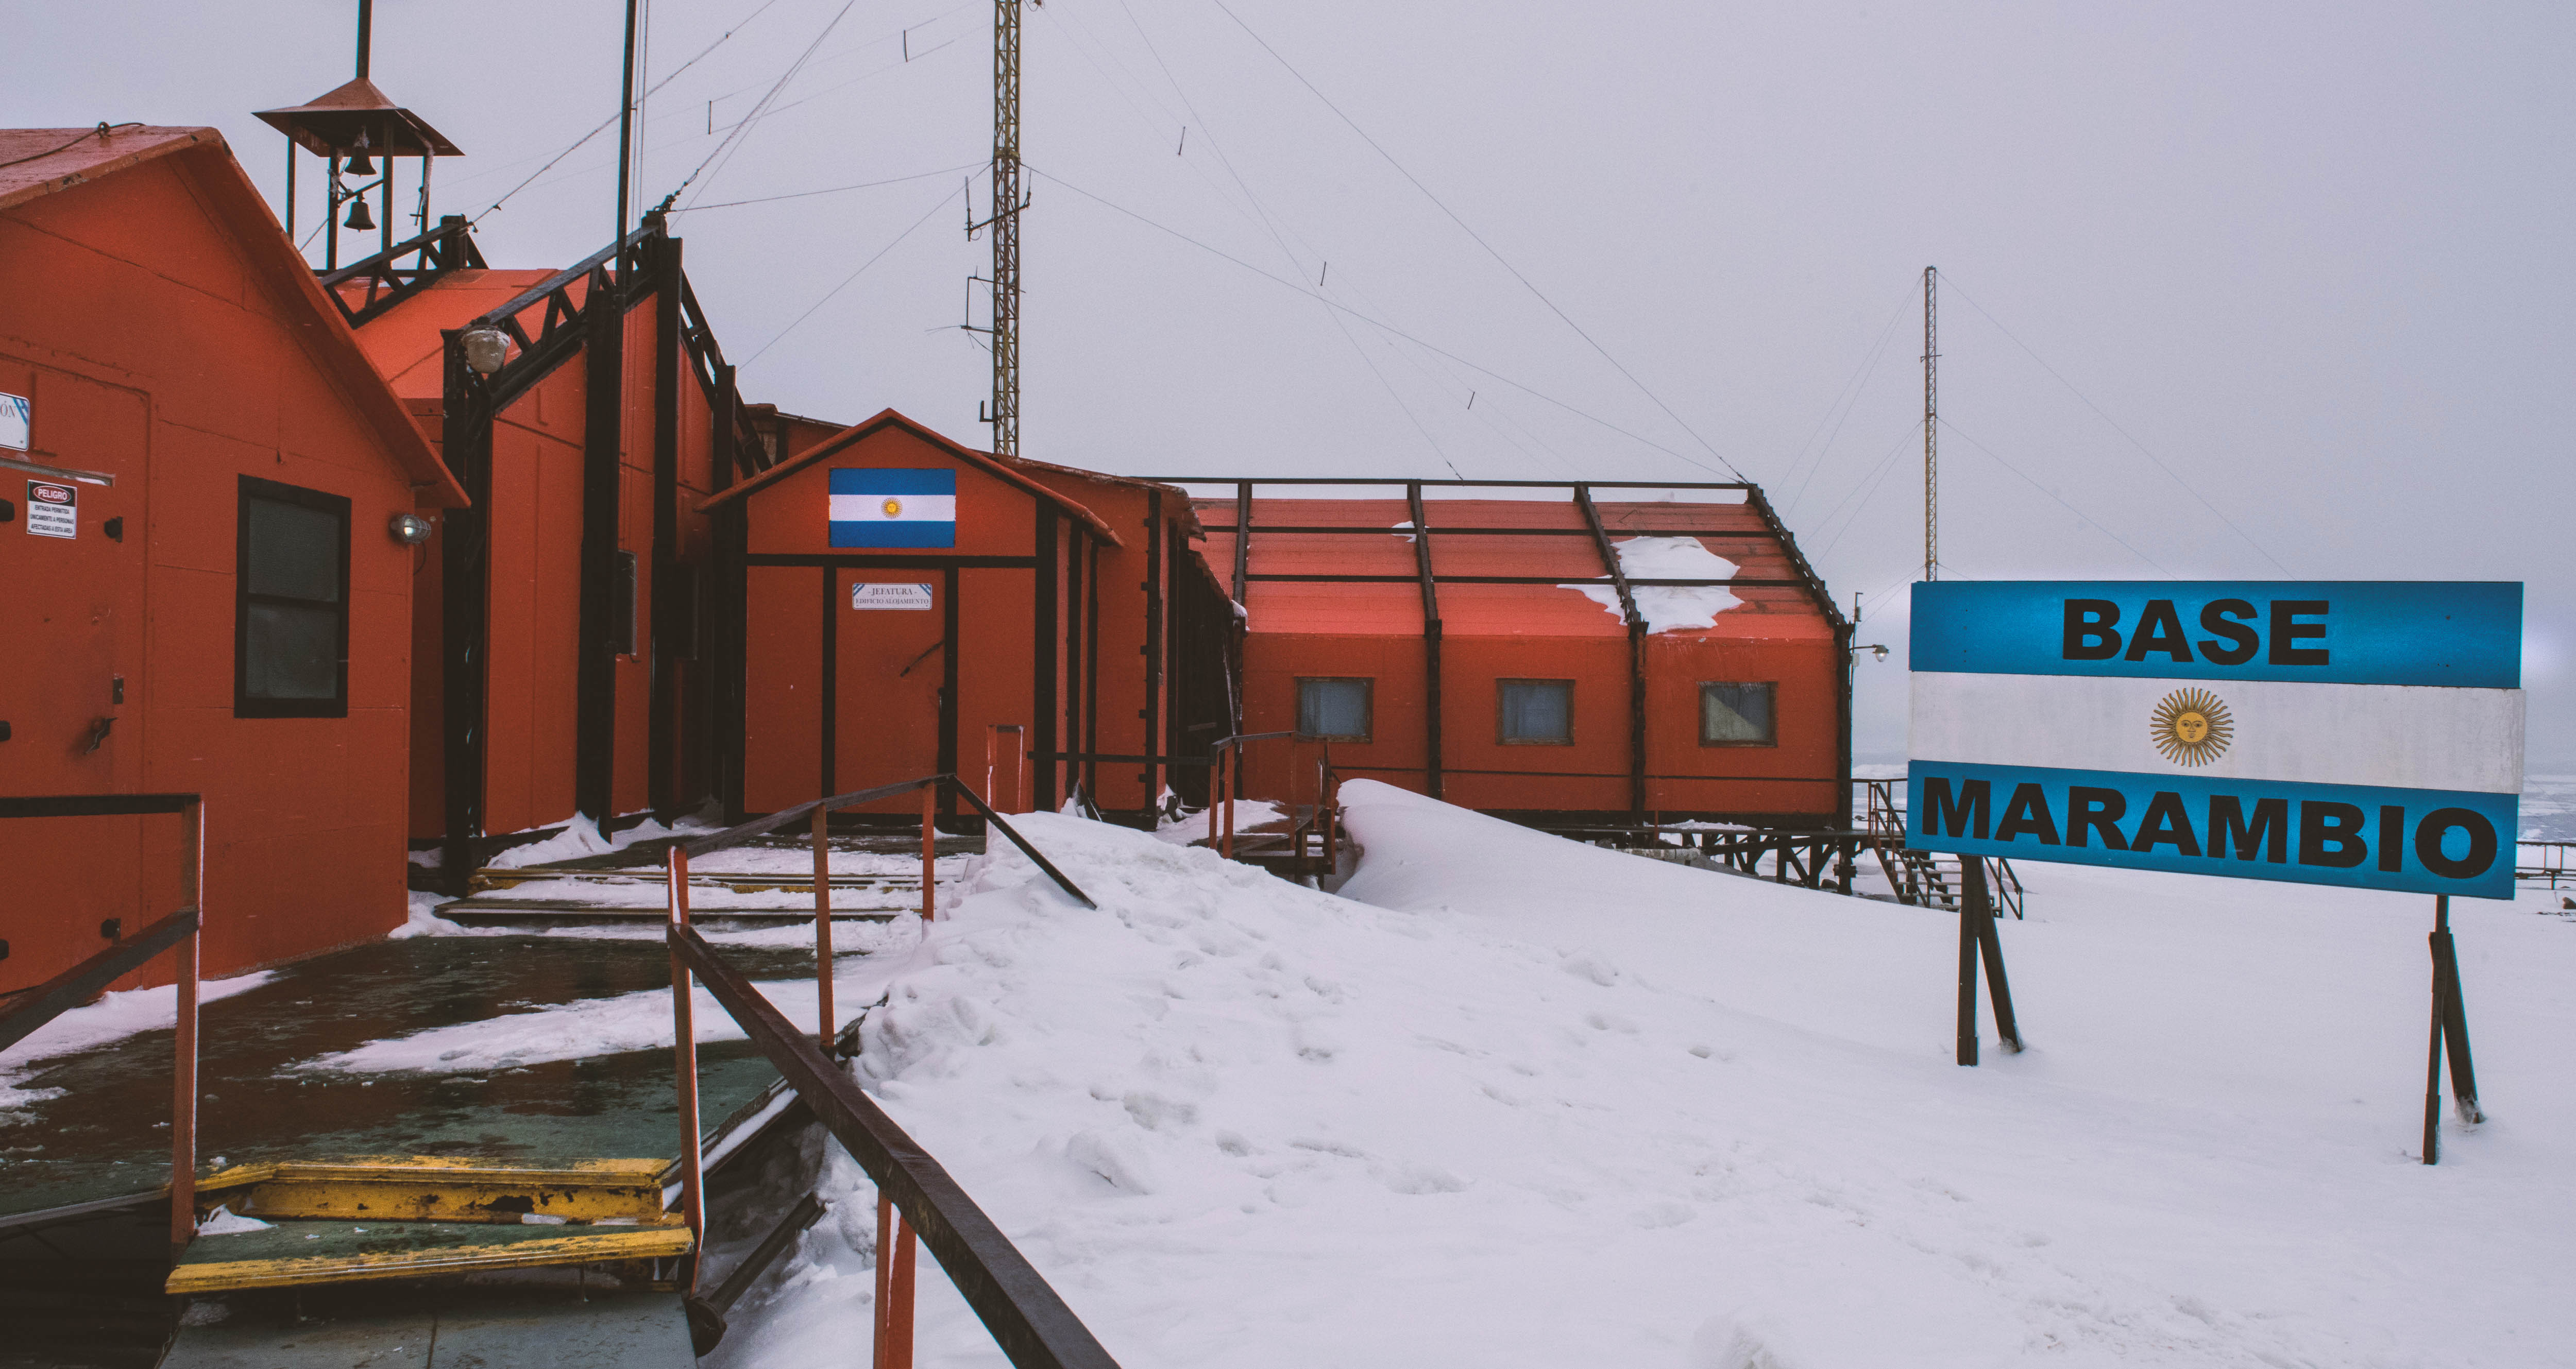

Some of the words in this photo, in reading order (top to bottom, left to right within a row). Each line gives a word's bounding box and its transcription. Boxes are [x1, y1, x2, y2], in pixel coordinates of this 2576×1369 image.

[38, 488, 67, 500] PELIGRO
[2062, 598, 2329, 666] BASE
[1922, 776, 2498, 879] MARAMBIO
